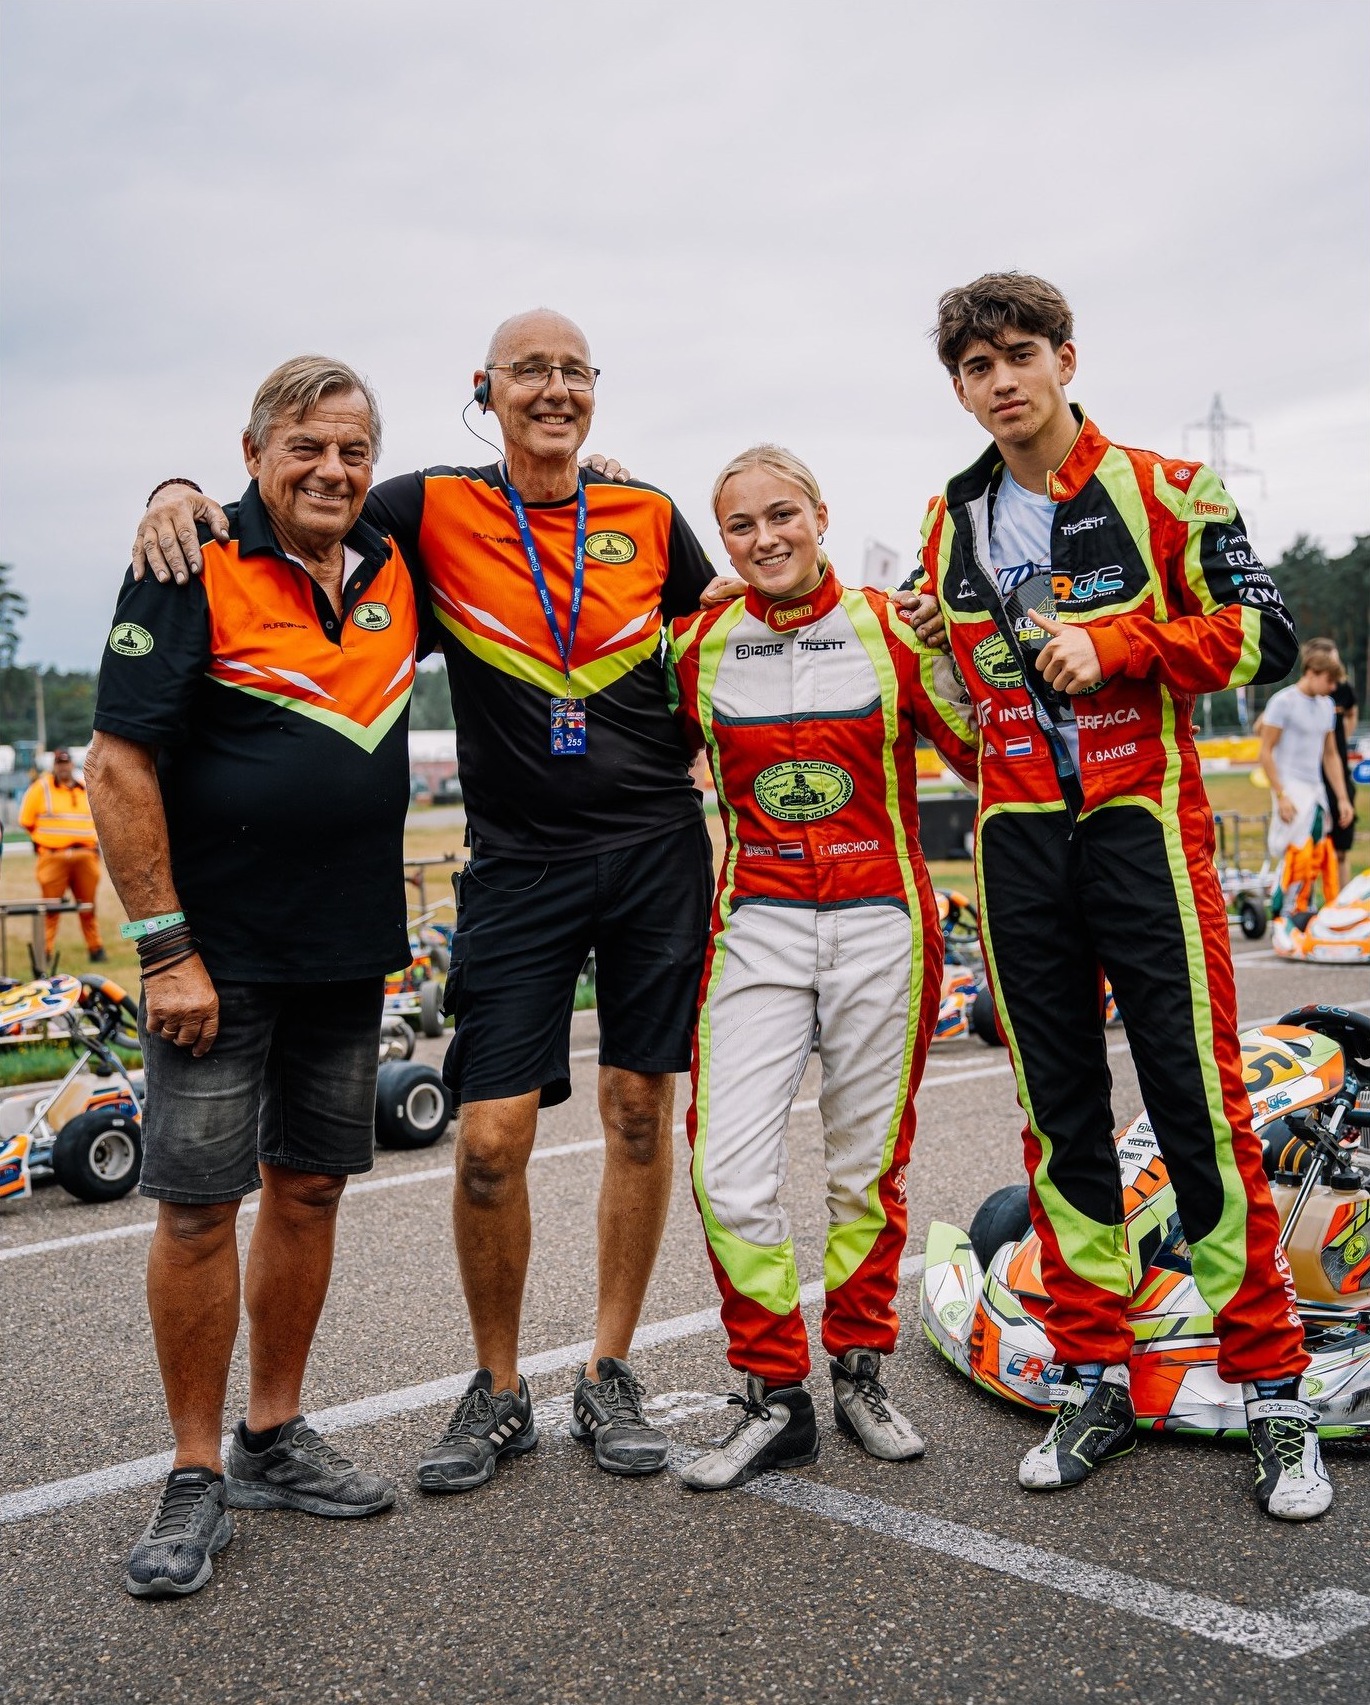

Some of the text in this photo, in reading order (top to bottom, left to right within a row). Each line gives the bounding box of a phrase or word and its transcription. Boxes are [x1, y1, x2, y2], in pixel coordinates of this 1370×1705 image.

[1194, 500, 1229, 516] freem
[472, 532, 524, 544] PUWEA
[774, 604, 812, 626] freem
[567, 738, 582, 747] 255
[1086, 742, 1138, 763] K. BAKKER
[764, 799, 846, 820] ROOSENDAAL
[819, 840, 879, 855] T. VERSCHOOR
[1119, 1149, 1143, 1161] freem
